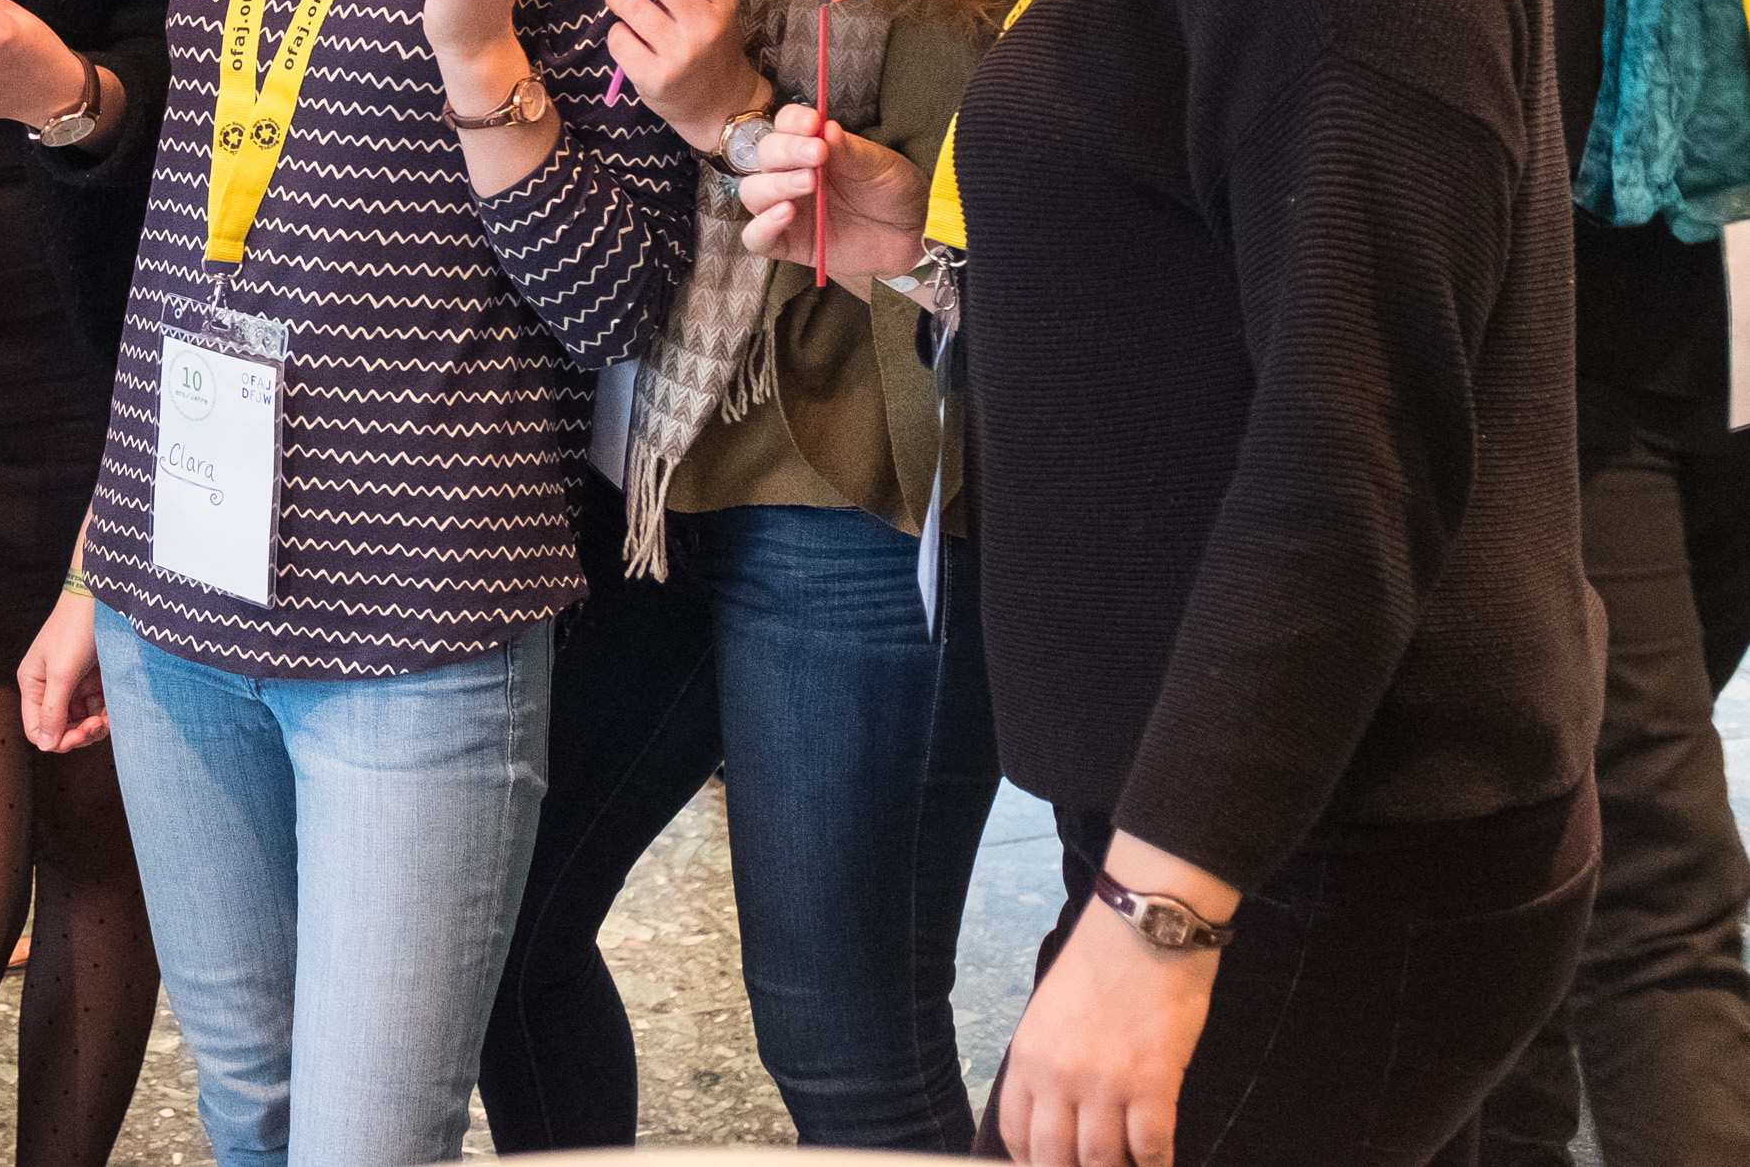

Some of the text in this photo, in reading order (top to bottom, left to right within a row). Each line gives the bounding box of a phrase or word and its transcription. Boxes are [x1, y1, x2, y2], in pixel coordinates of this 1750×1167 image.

[182, 366, 203, 392] 10
[241, 372, 272, 391] OFAJ
[241, 387, 272, 406] DFJW
[169, 442, 215, 482] Clara
